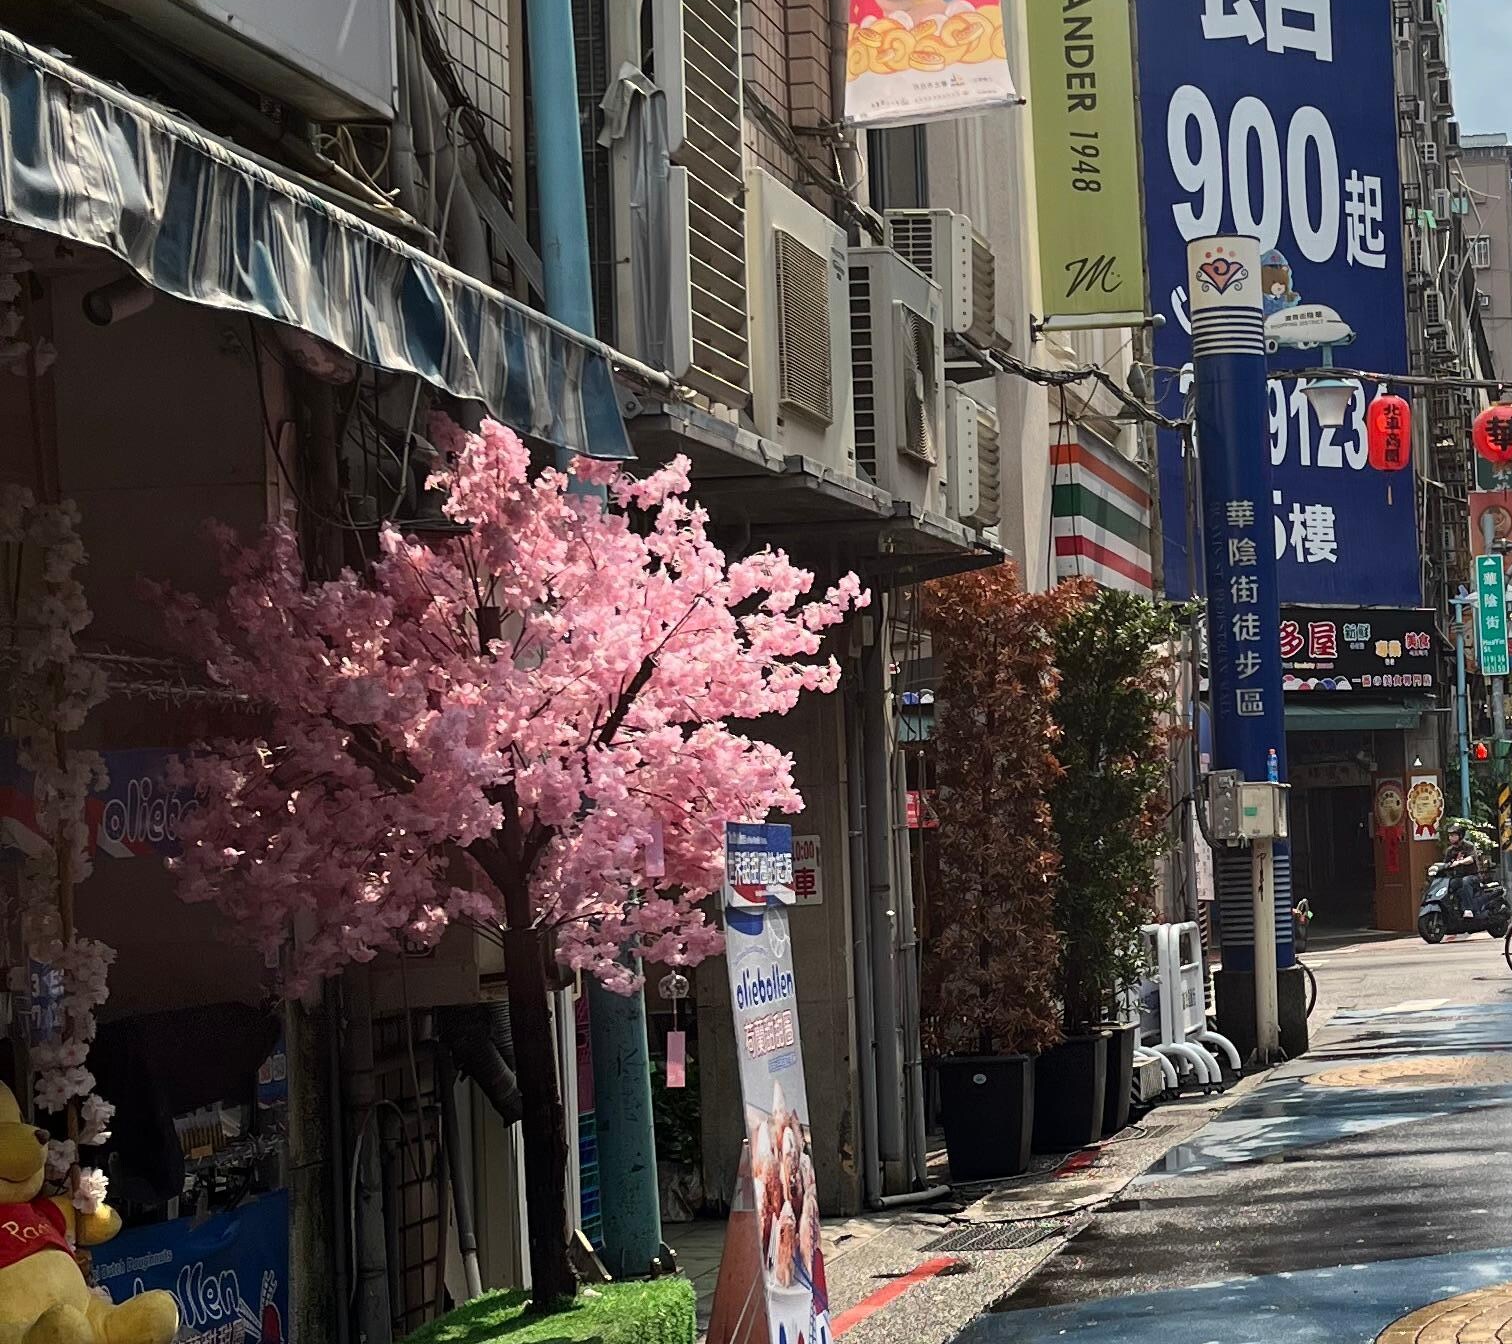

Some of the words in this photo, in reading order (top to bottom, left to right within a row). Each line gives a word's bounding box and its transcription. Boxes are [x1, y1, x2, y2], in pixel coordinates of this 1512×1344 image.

[1068, 131, 1103, 194] 1948
[1225, 500, 1265, 717] 華陰街徒步區
[1483, 572, 1500, 630] 華陰街
[794, 866, 817, 900] 車
[736, 962, 795, 1011] oliebollen
[743, 1009, 795, 1059] 荷蘭甜甜圈
